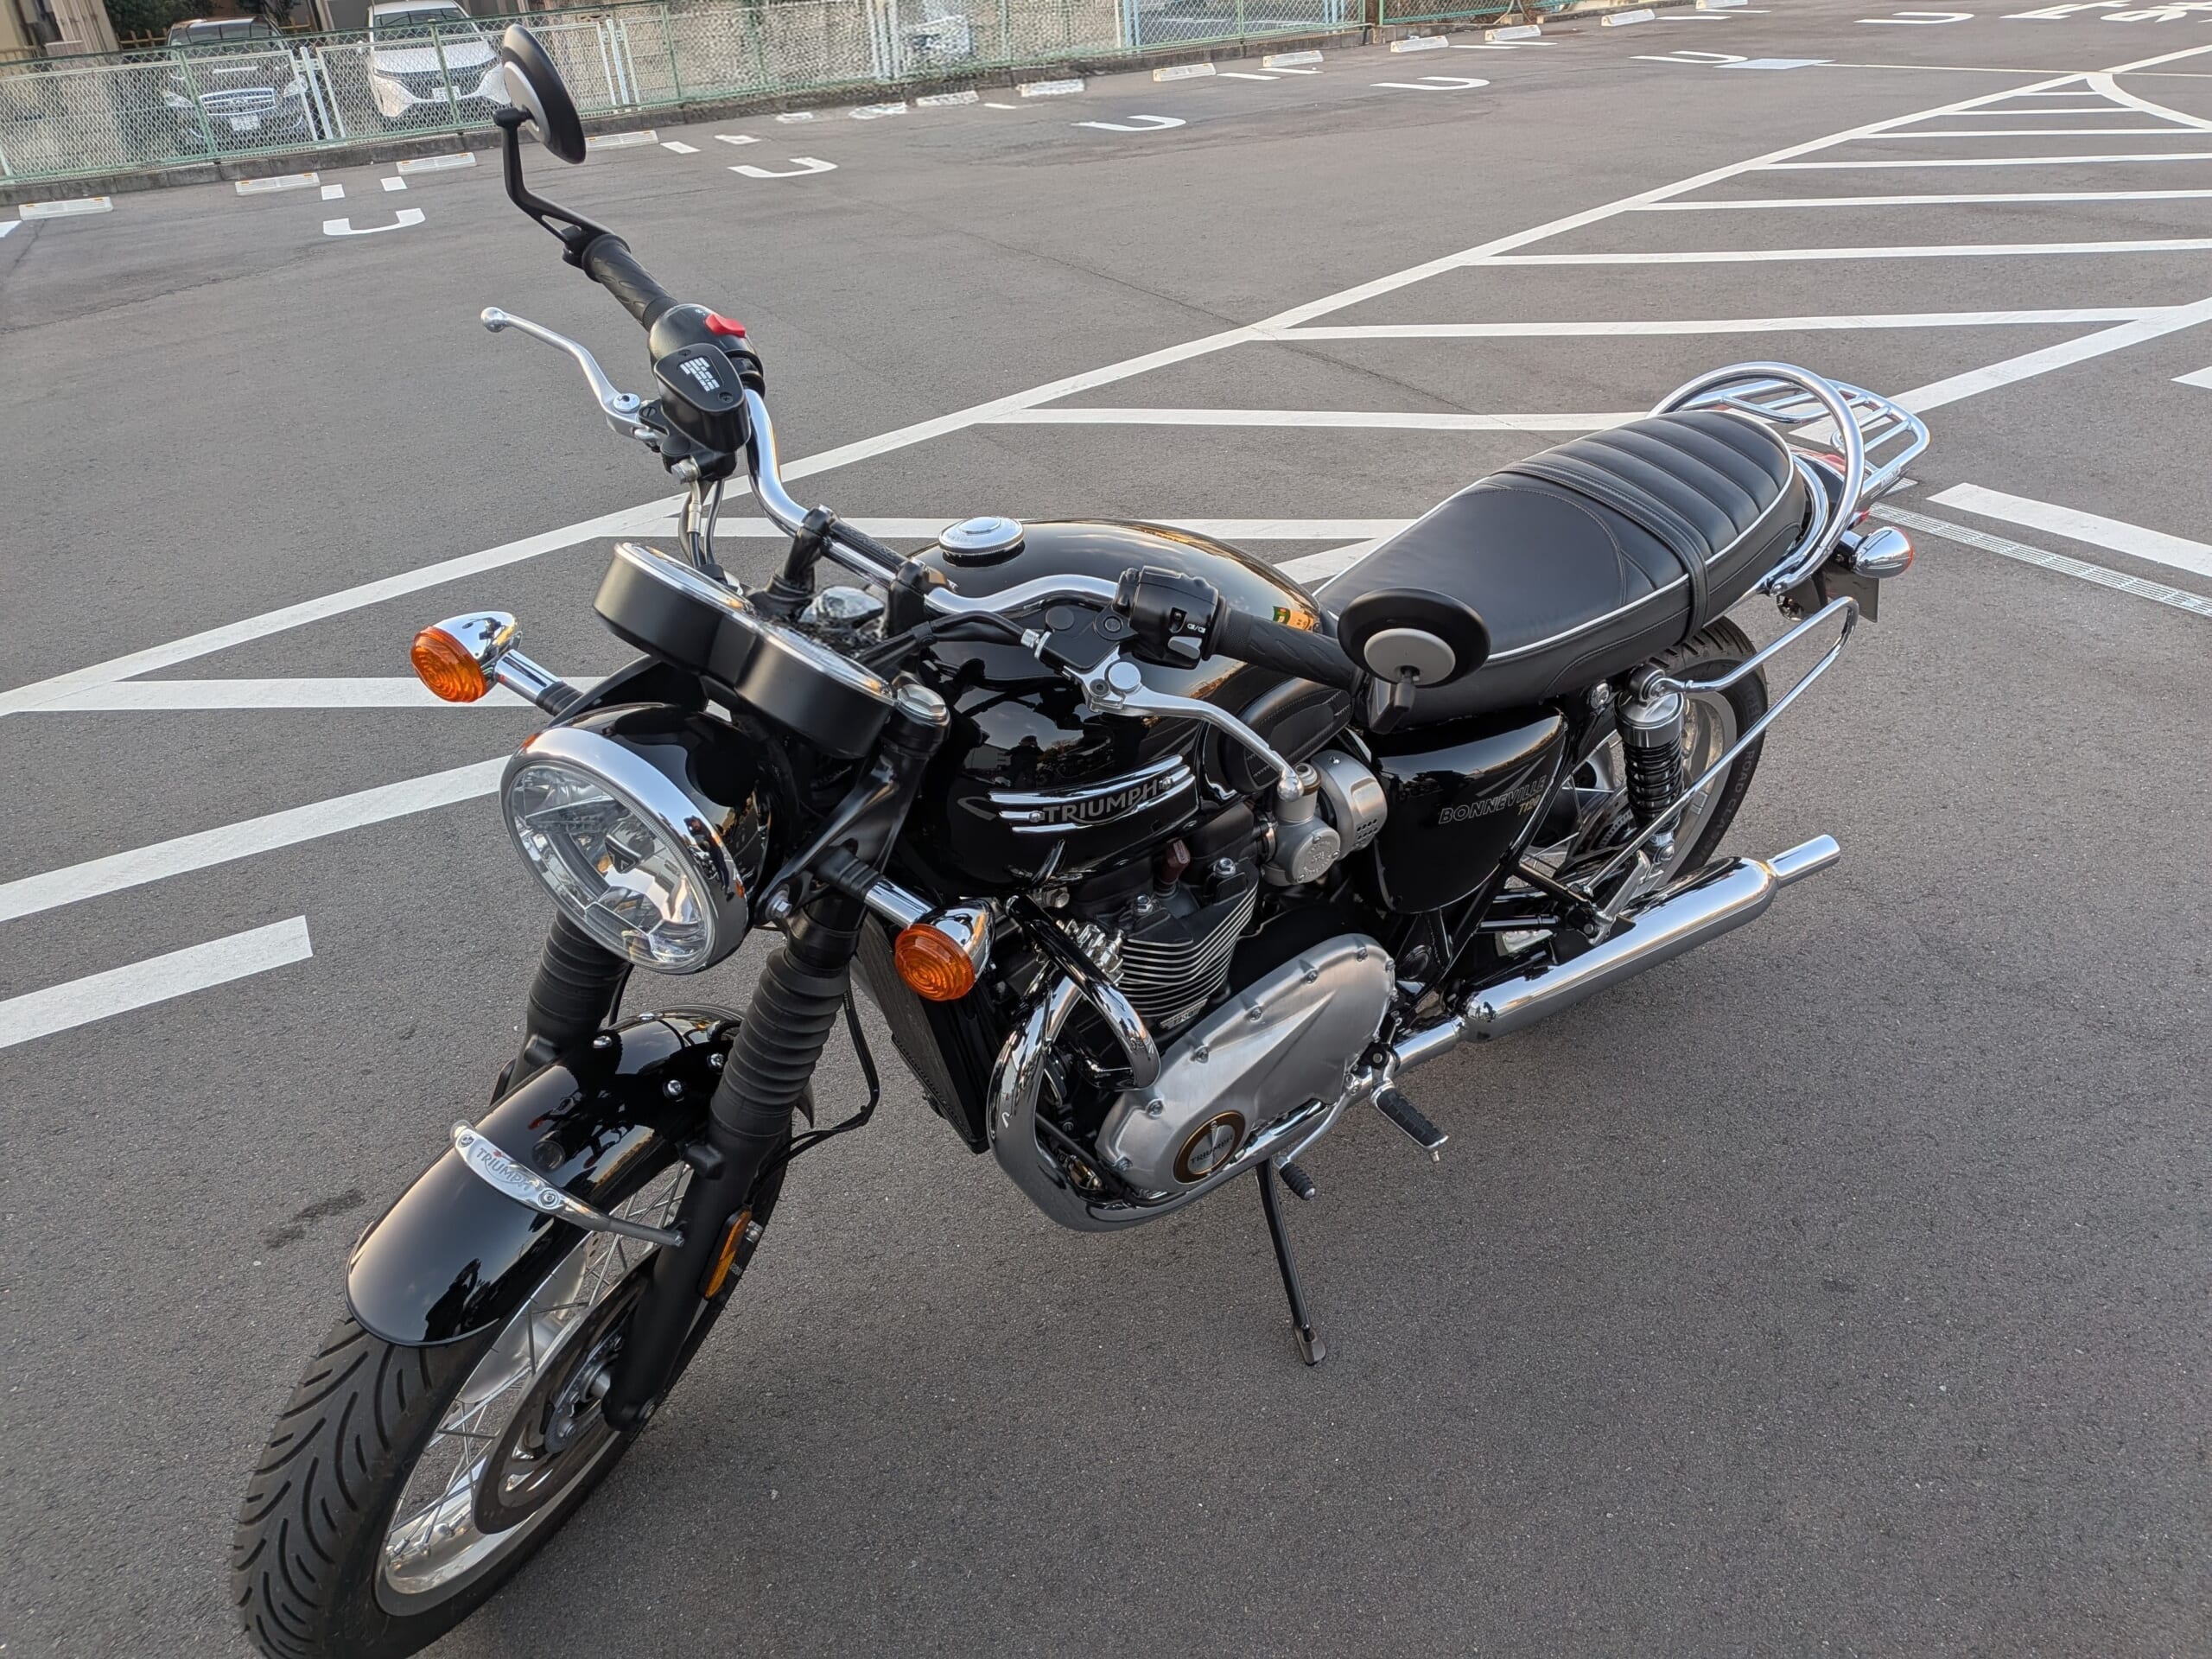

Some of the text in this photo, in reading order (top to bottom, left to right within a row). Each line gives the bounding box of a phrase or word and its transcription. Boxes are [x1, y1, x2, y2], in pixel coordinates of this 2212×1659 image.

[1999, 0, 2212, 23] 止ま
[1735, 749, 1755, 793] ROAD
[1042, 779, 1159, 823] TRIUMPH
[1438, 774, 1547, 824] BONNEVILLE
[1518, 795, 1541, 816] T120
[476, 1147, 535, 1192] TRIUMPH
[1190, 1134, 1234, 1164] TRIUMPH
